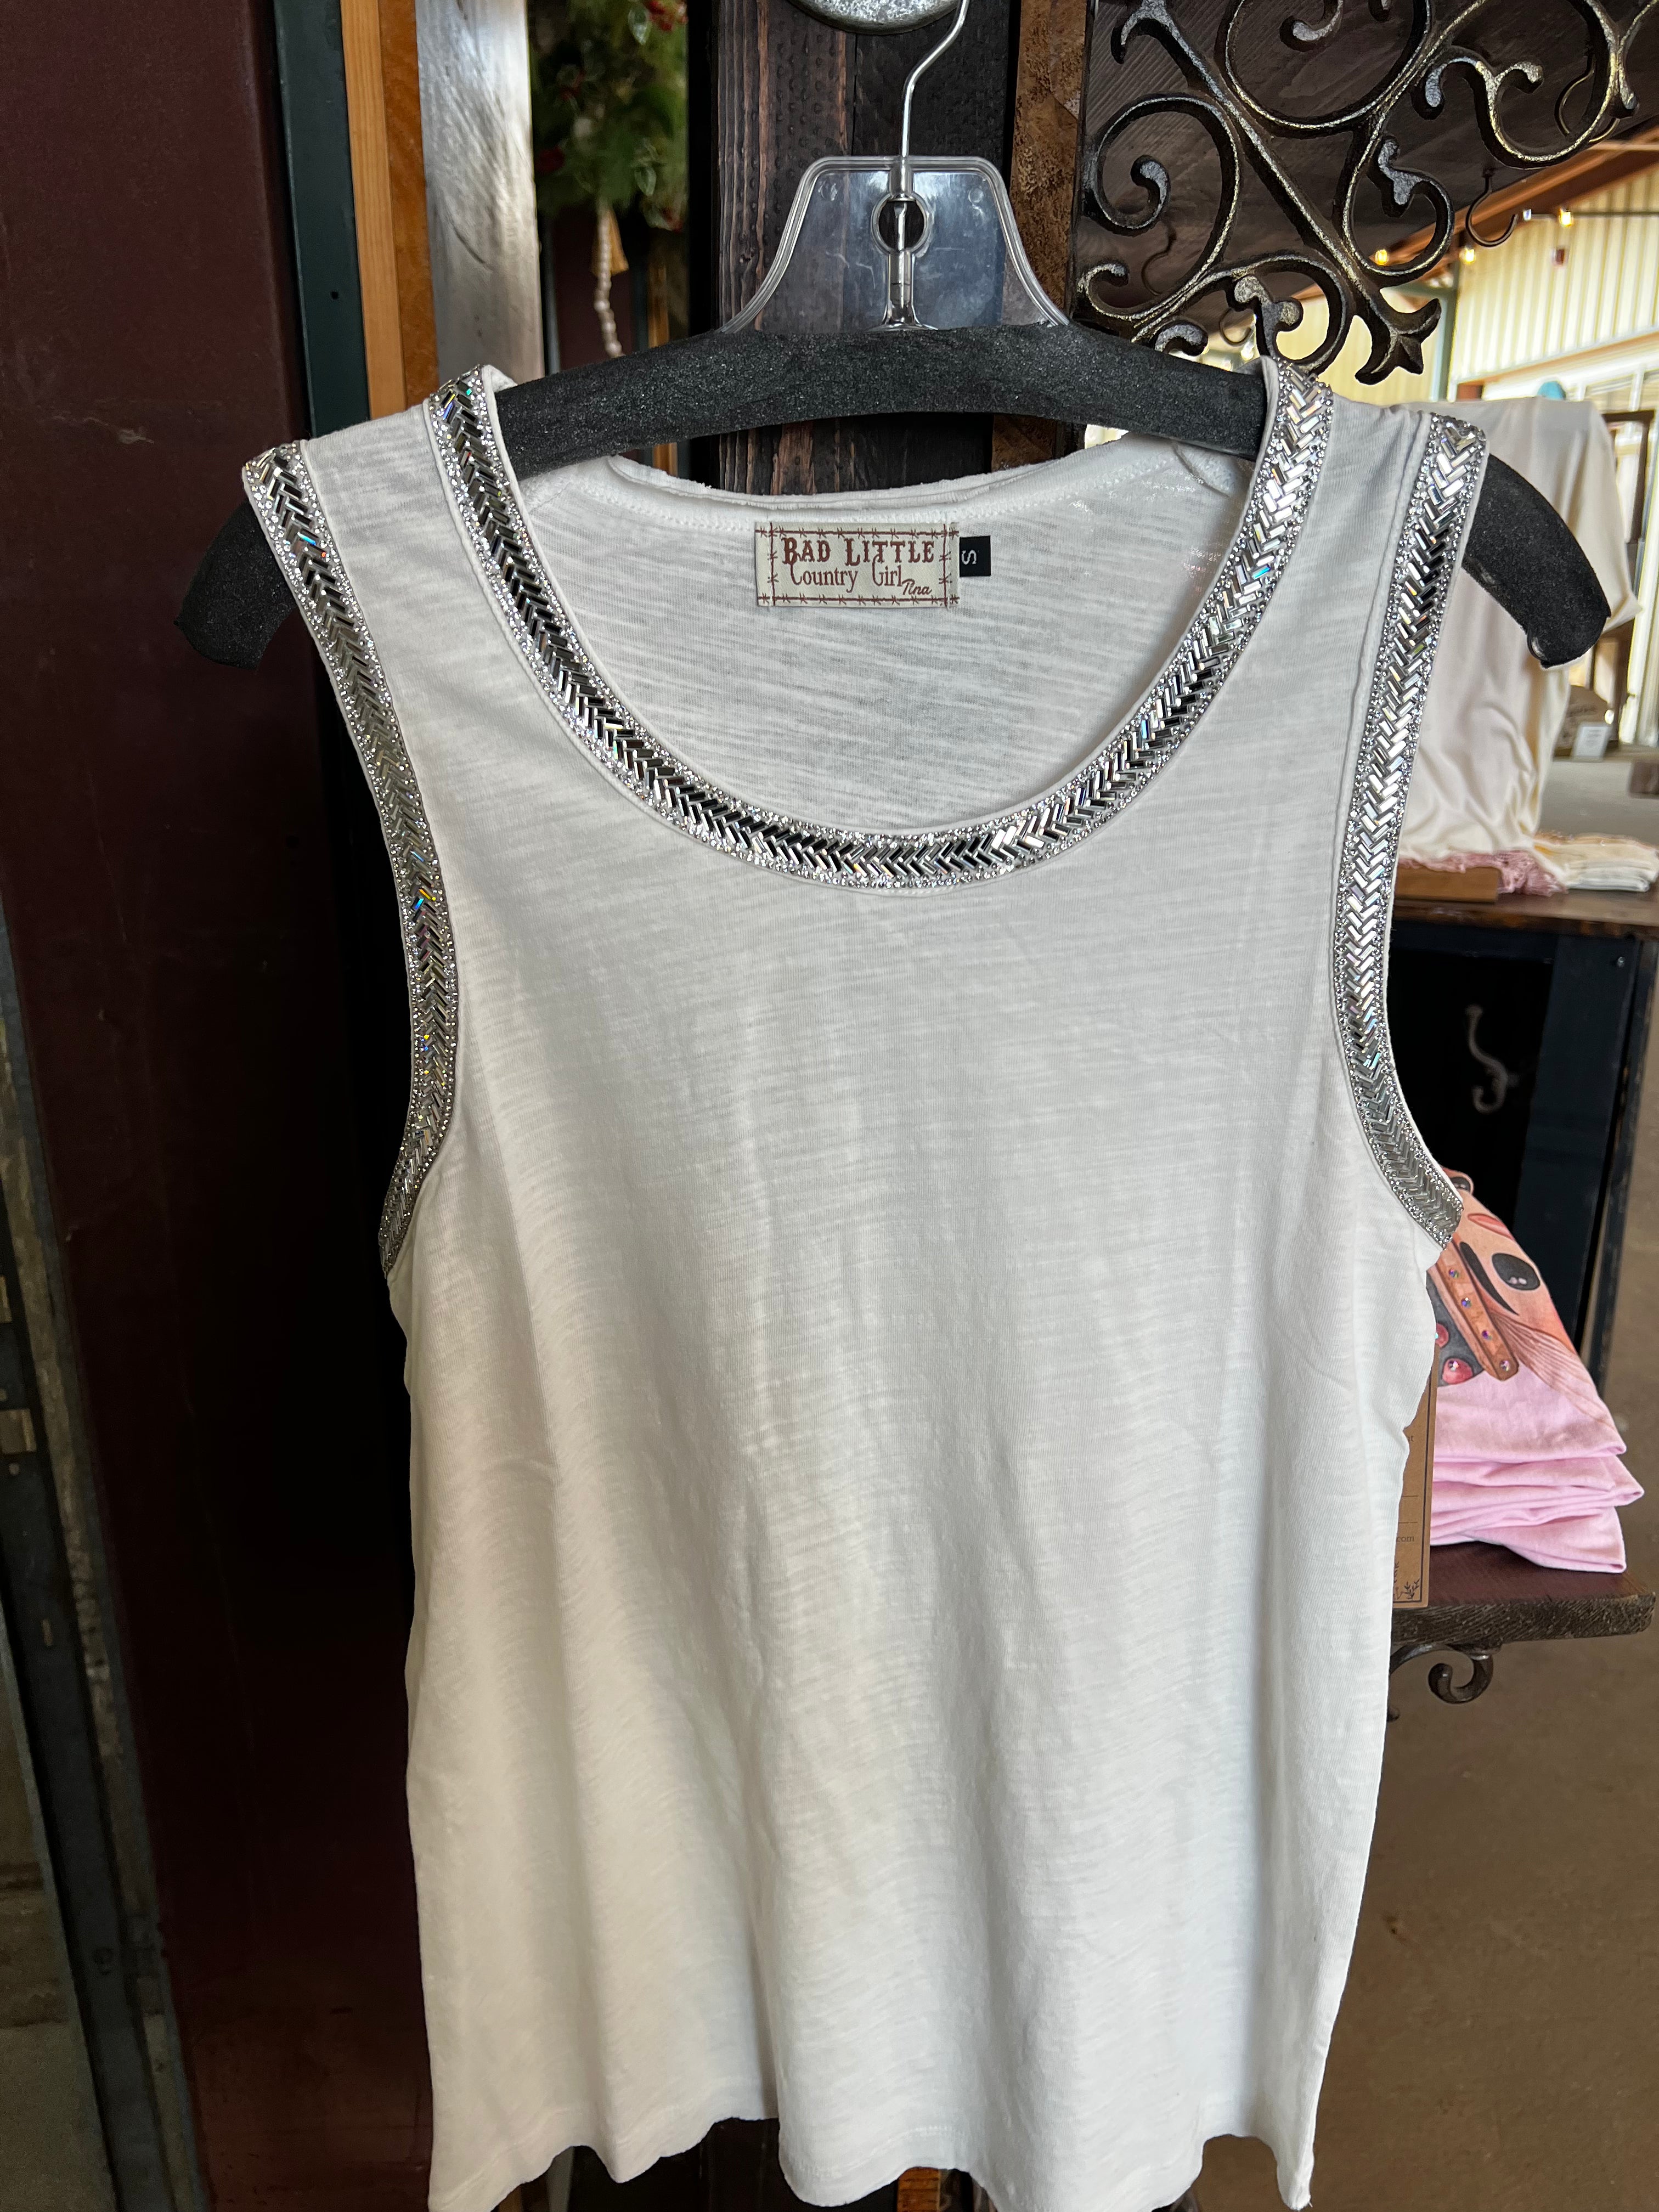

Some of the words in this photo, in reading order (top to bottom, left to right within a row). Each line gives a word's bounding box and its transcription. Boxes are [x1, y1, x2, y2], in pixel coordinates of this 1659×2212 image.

[781, 537, 831, 565] BAD
[844, 538, 934, 566] LITTLE
[961, 549, 977, 565] S
[790, 554, 859, 593] Country
[871, 554, 902, 586] Girl
